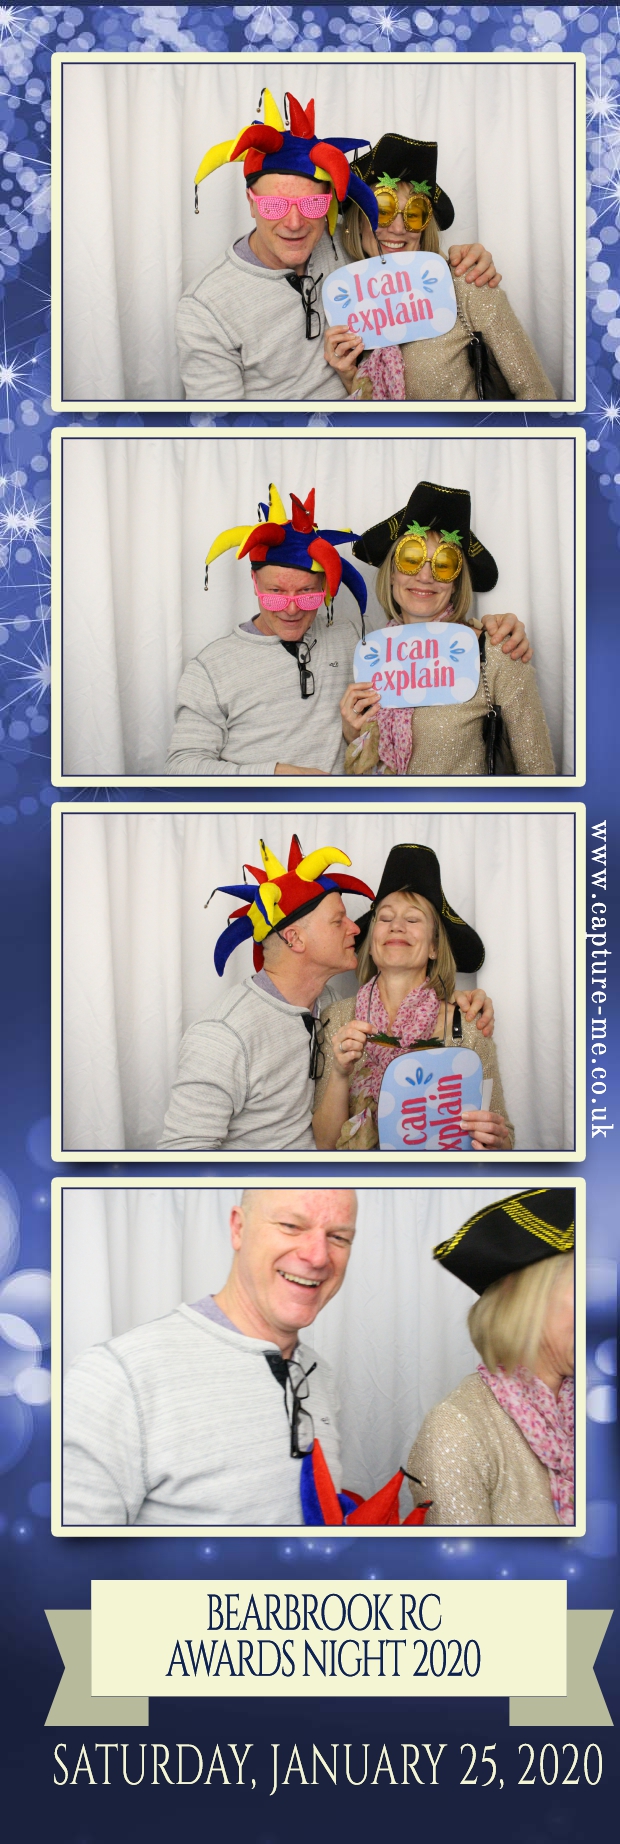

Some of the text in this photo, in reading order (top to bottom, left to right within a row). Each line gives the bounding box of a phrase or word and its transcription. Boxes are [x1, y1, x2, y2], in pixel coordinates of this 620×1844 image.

[353, 270, 413, 302] I can
[347, 292, 434, 336] explain
[385, 637, 439, 663] I can
[371, 660, 455, 696] explain
[401, 1096, 428, 1145] can
[429, 1074, 469, 1150] xplain
